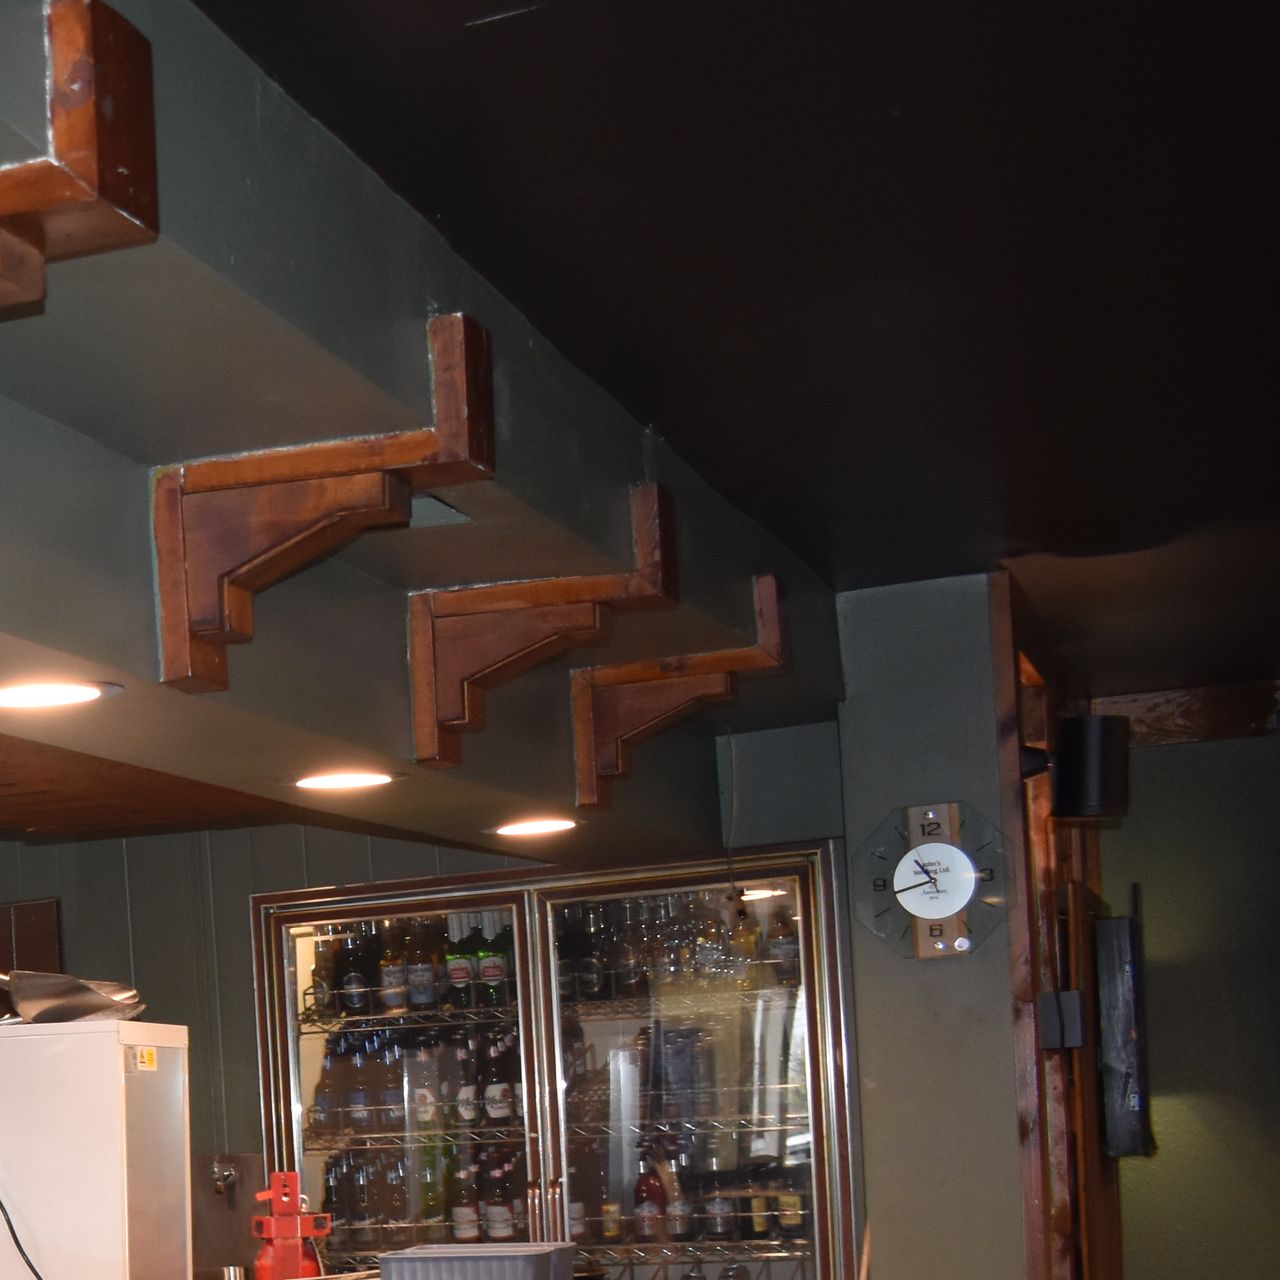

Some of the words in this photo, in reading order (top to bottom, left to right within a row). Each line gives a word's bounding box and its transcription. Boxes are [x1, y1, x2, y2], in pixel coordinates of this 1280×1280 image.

[920, 822, 941, 836] 12
[980, 867, 994, 882] 3
[873, 878, 887, 892] 9
[929, 924, 943, 938] 6
